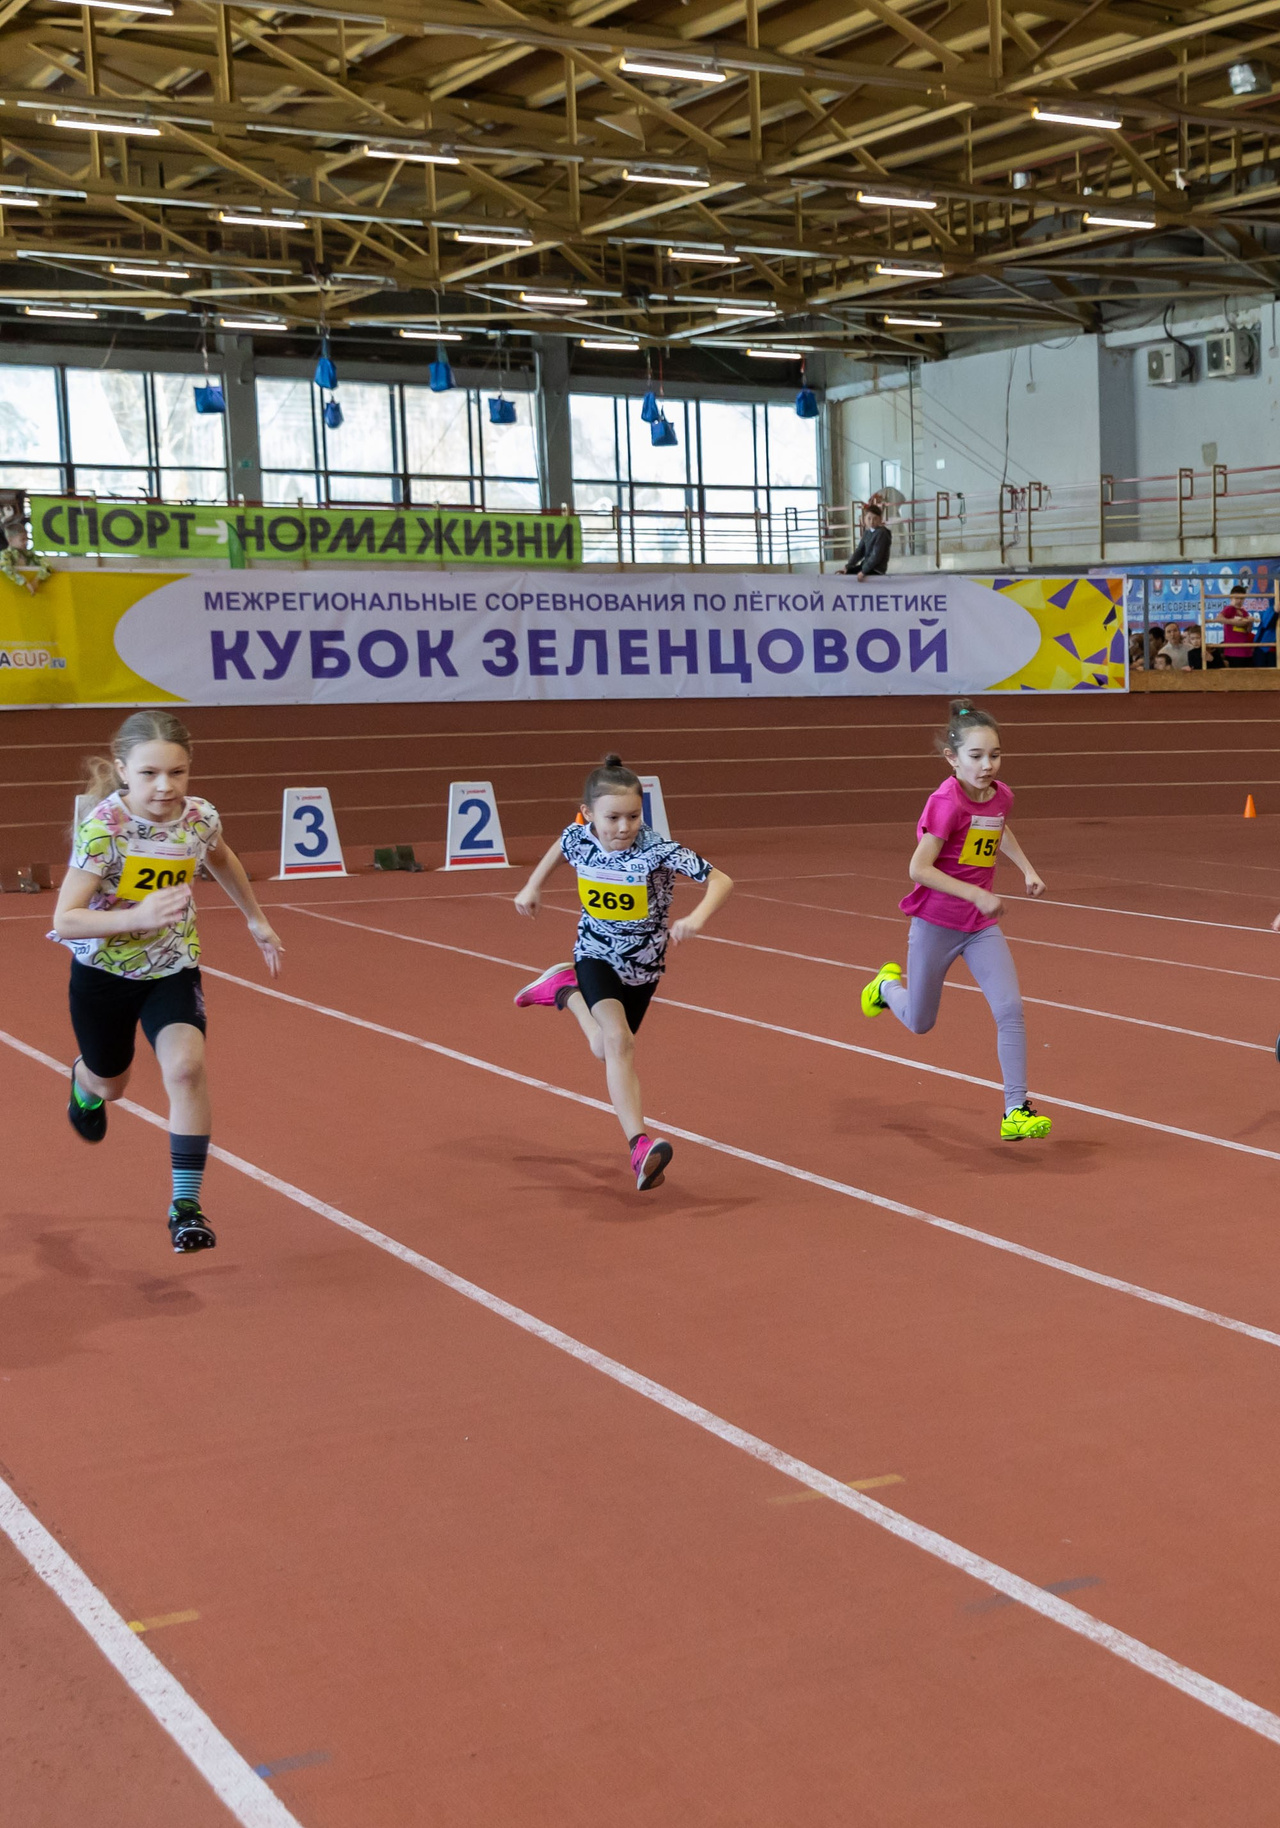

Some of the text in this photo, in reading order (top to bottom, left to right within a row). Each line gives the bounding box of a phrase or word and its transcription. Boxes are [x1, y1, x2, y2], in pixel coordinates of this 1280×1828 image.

[42, 505, 197, 550] СПОРТ
[416, 517, 575, 560] ЖИЗНИ
[203, 590, 948, 612] МЕЖРЕГИОНАЛЬНЫЕ СОРЕВНОВАНИЯ ПО ЛЁГКОЙ АТЛЕТИКЕ
[210, 618, 949, 684] КУБОК ЗЕЛЕНЦОВОЙ
[292, 804, 329, 858] 3
[458, 798, 494, 850] 2
[134, 867, 188, 890] 208
[587, 889, 635, 911] 269
